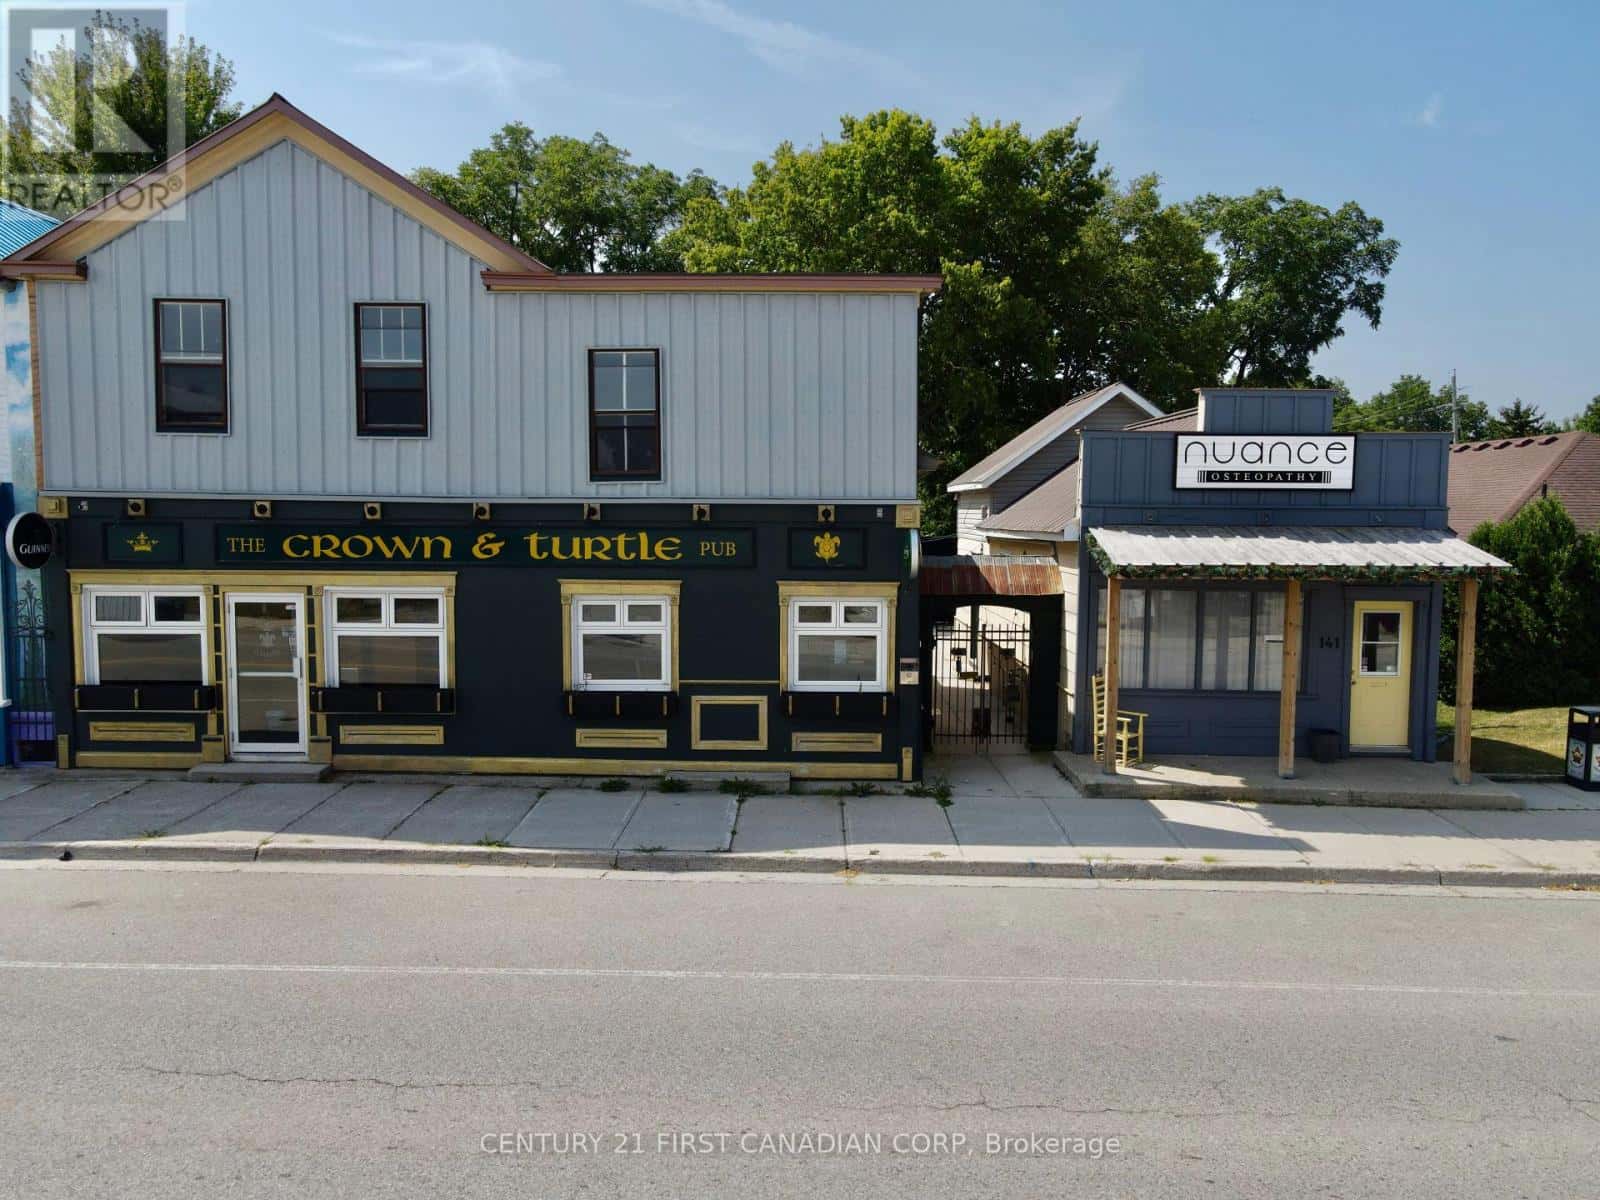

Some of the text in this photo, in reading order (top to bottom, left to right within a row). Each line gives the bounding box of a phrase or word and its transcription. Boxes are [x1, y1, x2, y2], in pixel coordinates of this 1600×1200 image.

[1184, 441, 1347, 464] nuance
[1211, 472, 1317, 482] OSTEOPATHY
[226, 538, 266, 553] THE
[471, 532, 505, 560] &
[700, 542, 736, 556] PUB
